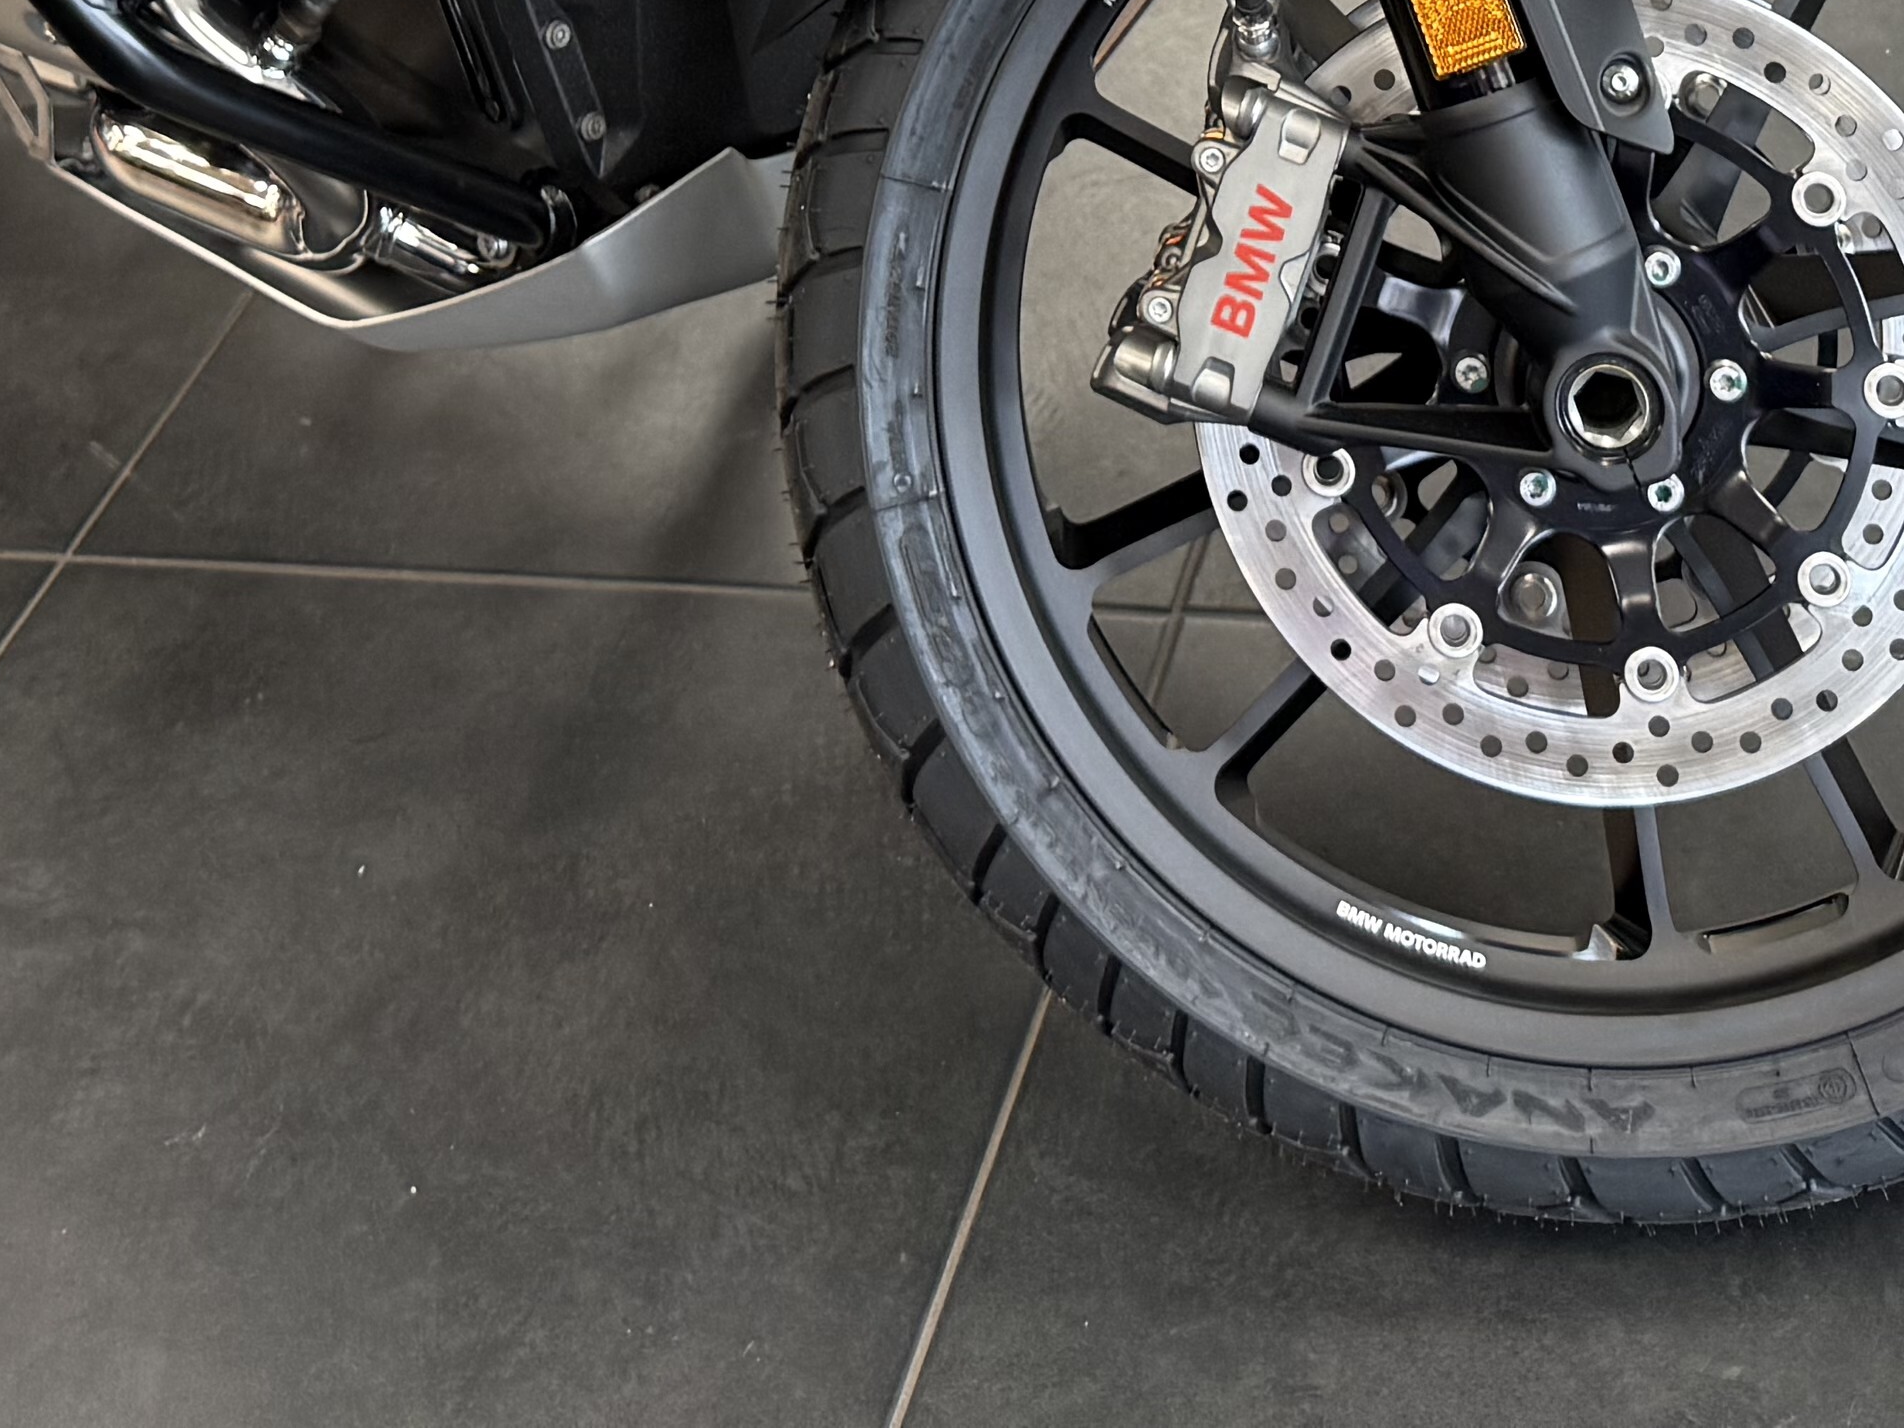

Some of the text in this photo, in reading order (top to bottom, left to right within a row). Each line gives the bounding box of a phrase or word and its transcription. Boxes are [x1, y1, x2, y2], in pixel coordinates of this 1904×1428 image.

[1210, 182, 1296, 340] BMW
[1337, 901, 1486, 968] BMW MOTORRAD
